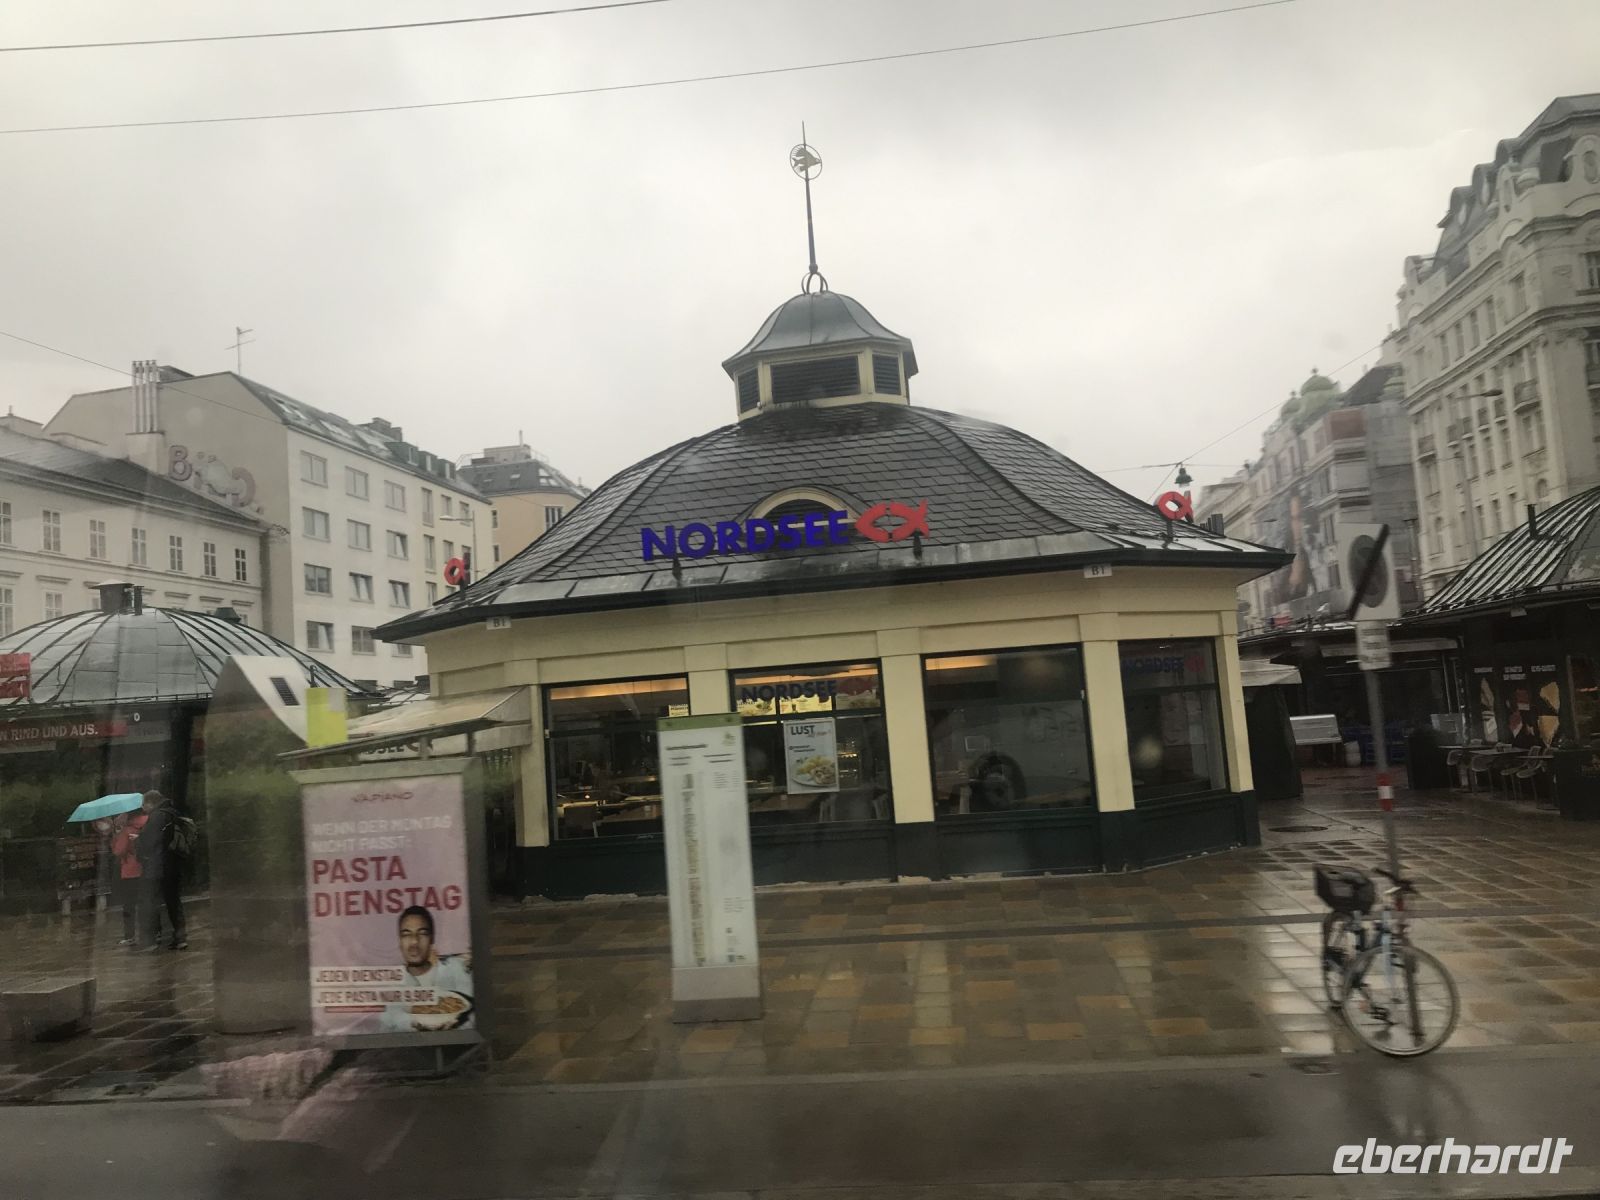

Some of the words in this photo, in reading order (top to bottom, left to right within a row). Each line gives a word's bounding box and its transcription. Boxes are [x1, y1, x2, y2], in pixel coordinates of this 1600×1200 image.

[641, 510, 850, 562] NORDSEE
[742, 679, 837, 703] NORDSEE
[42, 725, 68, 738] UND
[790, 725, 815, 736] LUST
[358, 819, 390, 834] DER
[311, 838, 356, 853] NICHT
[312, 855, 407, 885] PASTA
[314, 885, 462, 918] DIENSTAG
[316, 969, 350, 983] JEDEN
[352, 968, 404, 982] DIENSTAG
[345, 990, 378, 1003] PASTA
